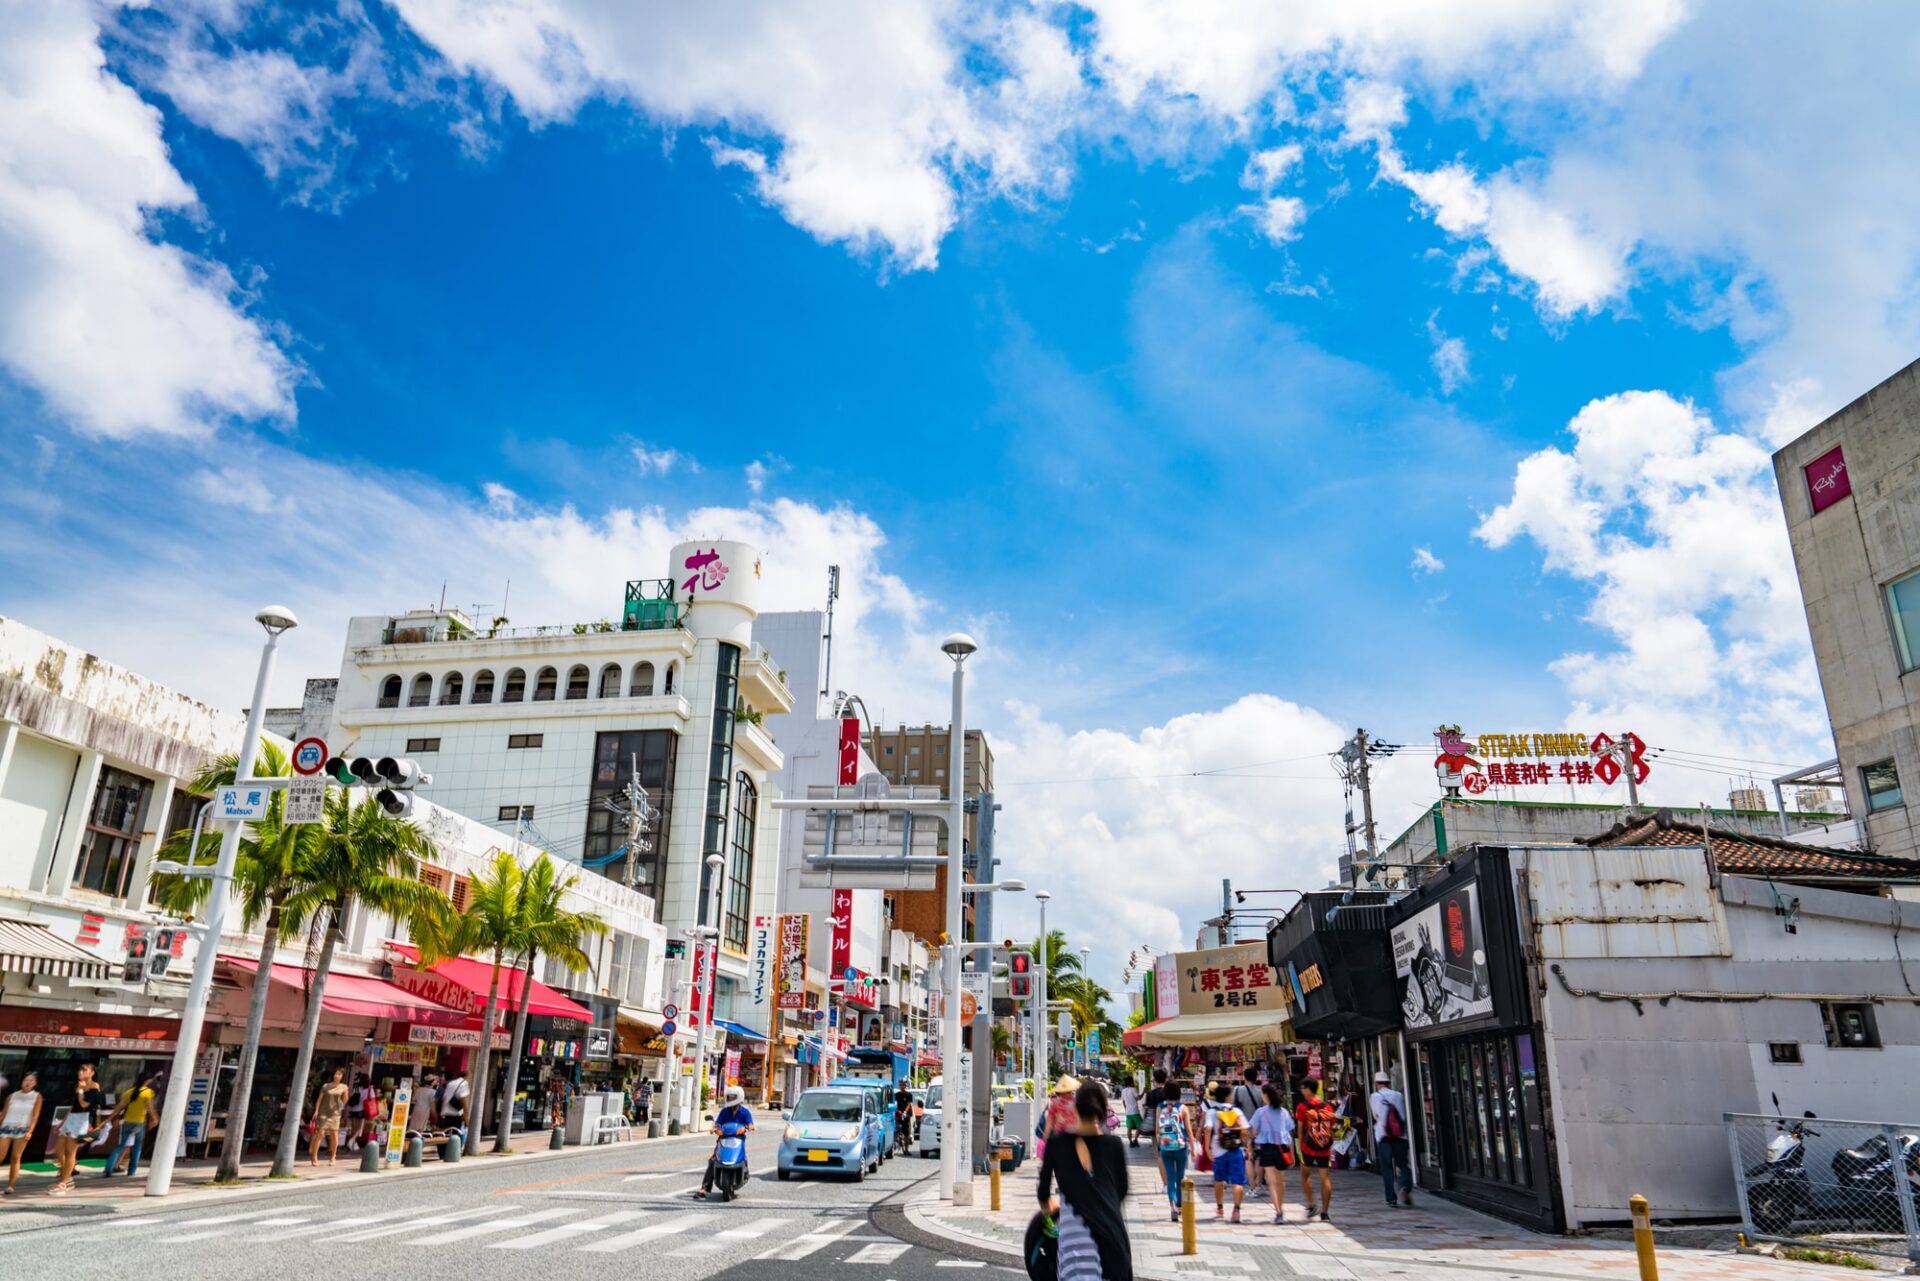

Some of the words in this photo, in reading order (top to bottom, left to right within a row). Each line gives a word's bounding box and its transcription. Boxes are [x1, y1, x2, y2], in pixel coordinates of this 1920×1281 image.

[681, 548, 722, 593] 花
[1478, 733, 1532, 758] STEAK
[1533, 733, 1590, 757] DINING
[843, 740, 858, 785] ハイ
[1487, 762, 1553, 785] 県産和牛
[223, 791, 261, 805] 松尾
[225, 807, 252, 815] Matsuo
[792, 915, 801, 952] この地下
[834, 893, 850, 950] わビル
[754, 930, 767, 1005] ココカラファイン
[1200, 963, 1271, 992] 東宝堂
[1214, 991, 1257, 1008] 2号店
[2, 1033, 30, 1045] COIN
[44, 1034, 85, 1046] STAMP
[184, 1078, 209, 1137] 三宝堂
